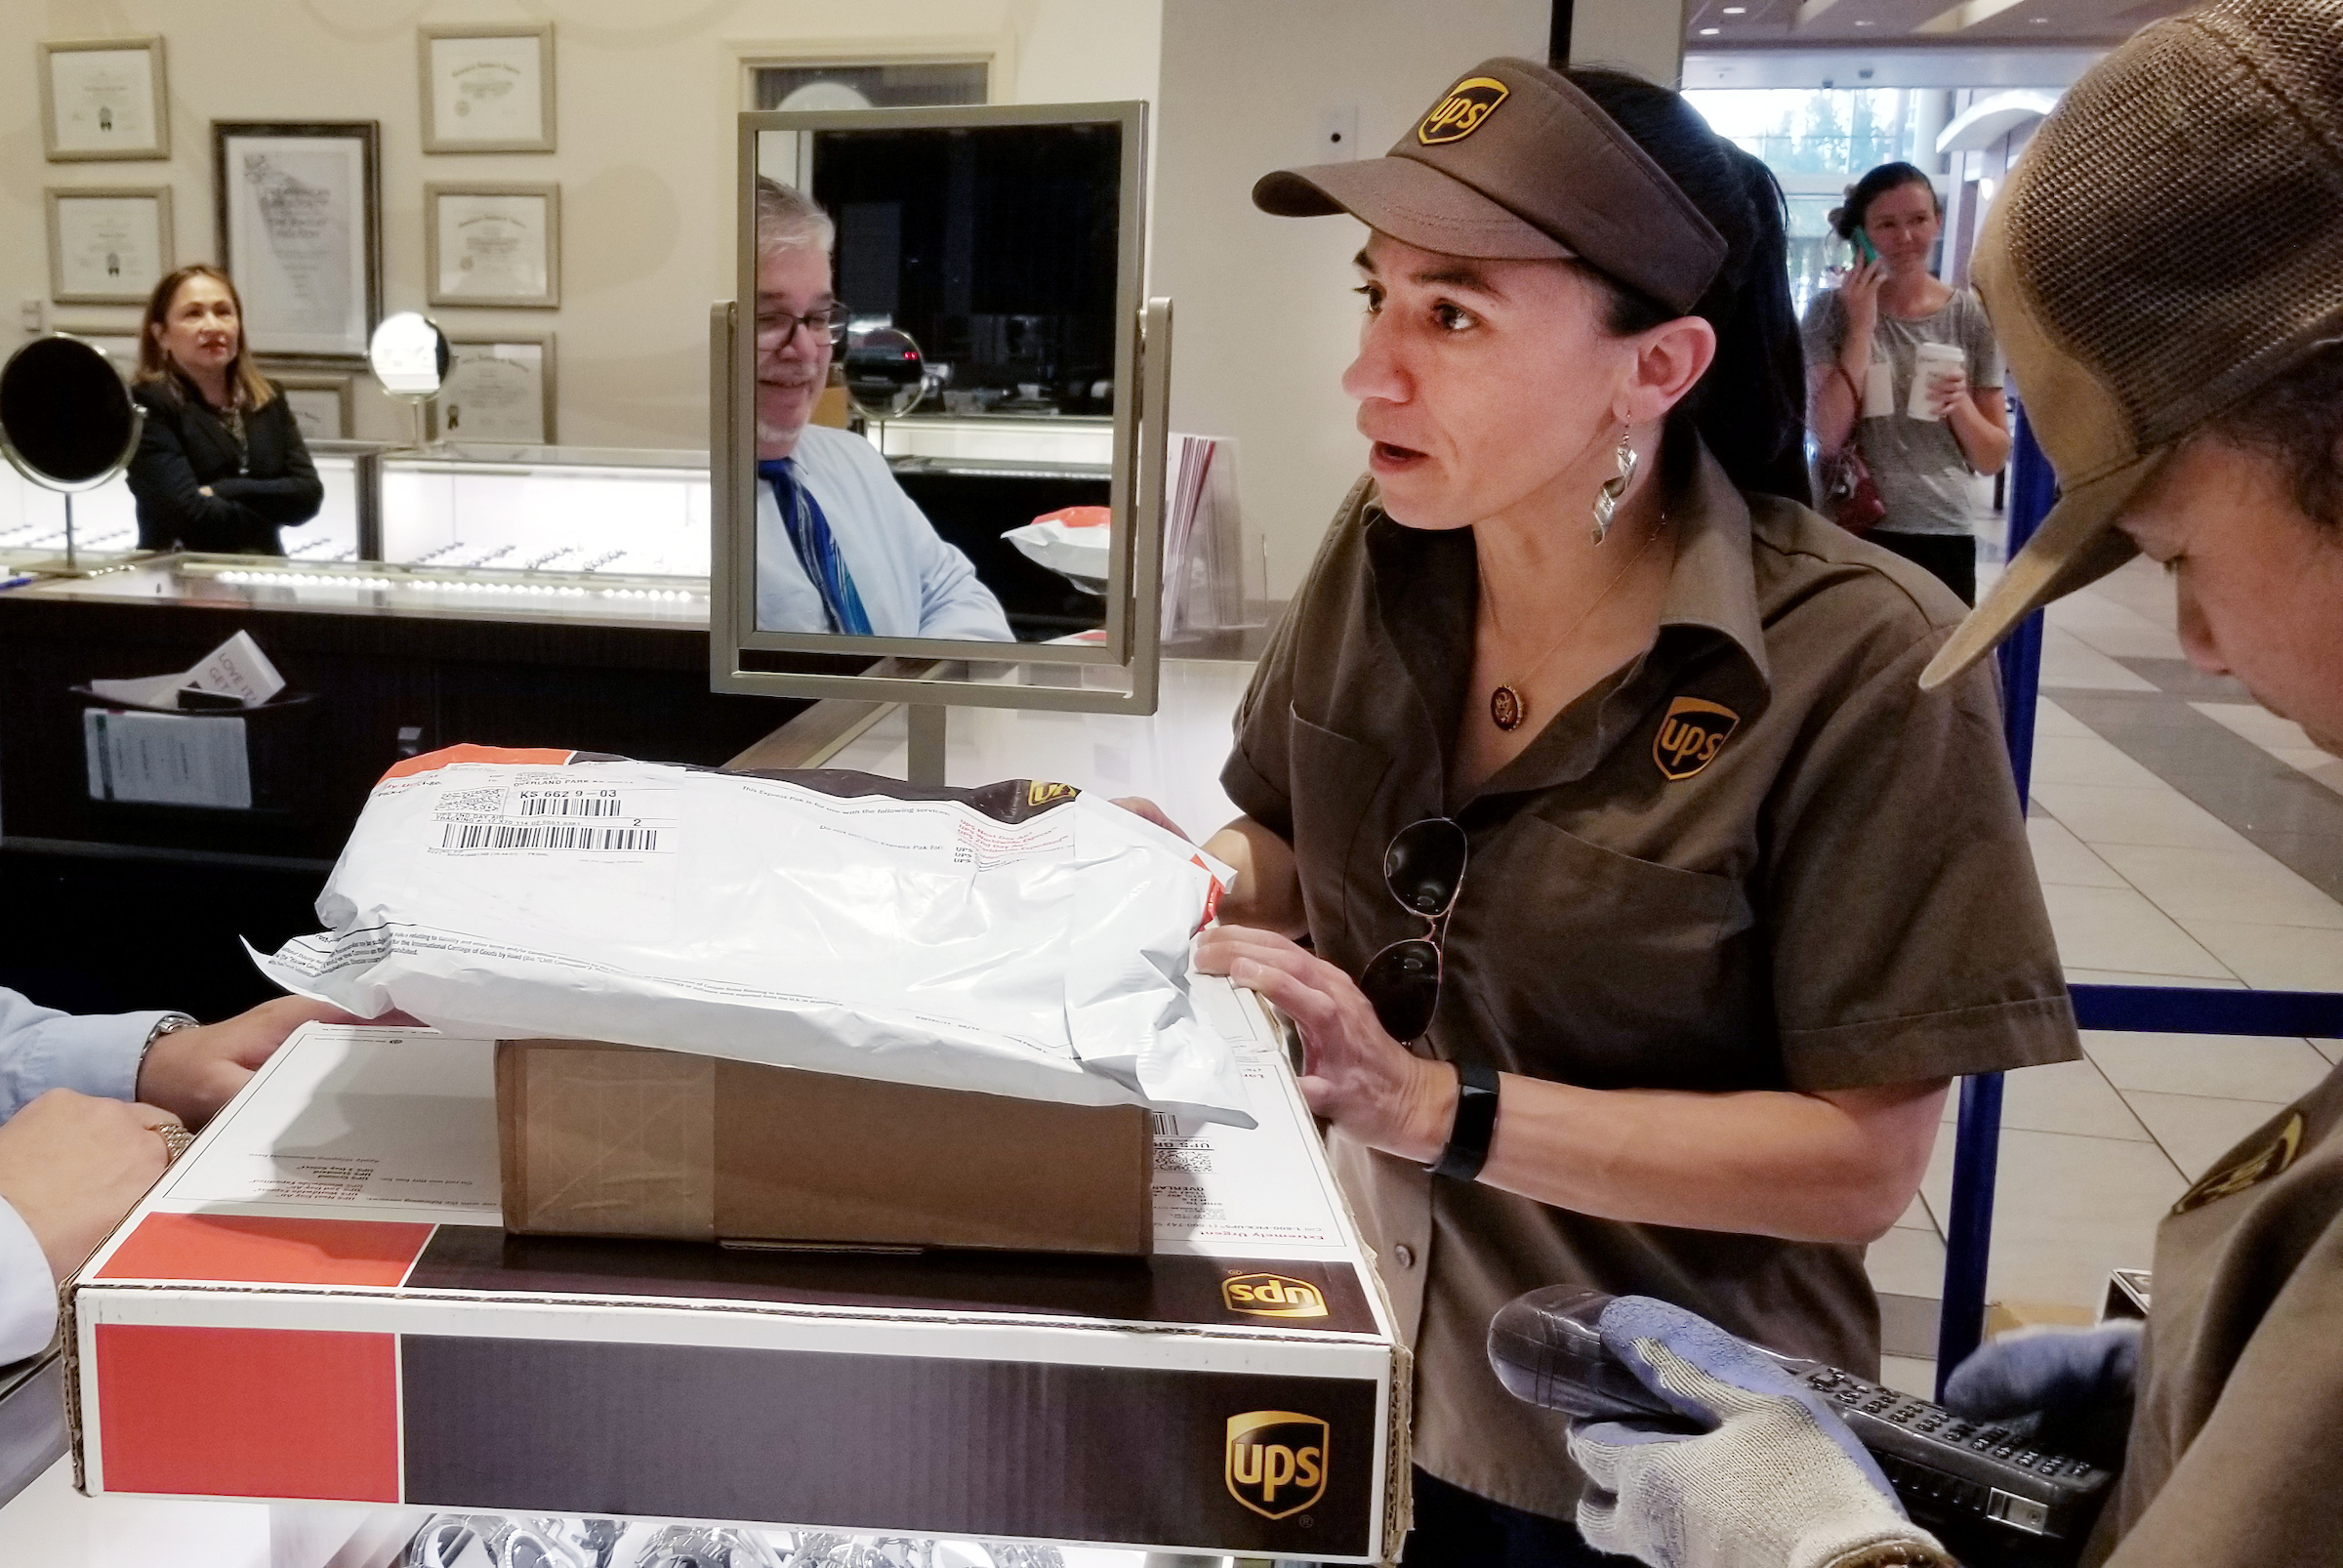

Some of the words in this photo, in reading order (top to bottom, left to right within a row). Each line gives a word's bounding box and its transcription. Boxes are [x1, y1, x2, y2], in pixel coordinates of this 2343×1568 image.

[1430, 98, 1488, 133] ups
[210, 668, 229, 690] GET
[219, 652, 242, 682] LOVE
[1661, 718, 1724, 766] ups
[520, 790, 538, 799] KS
[544, 790, 570, 799] 662
[633, 818, 642, 827] 2
[1228, 1279, 1316, 1304] ups
[1234, 1443, 1320, 1502] ups
